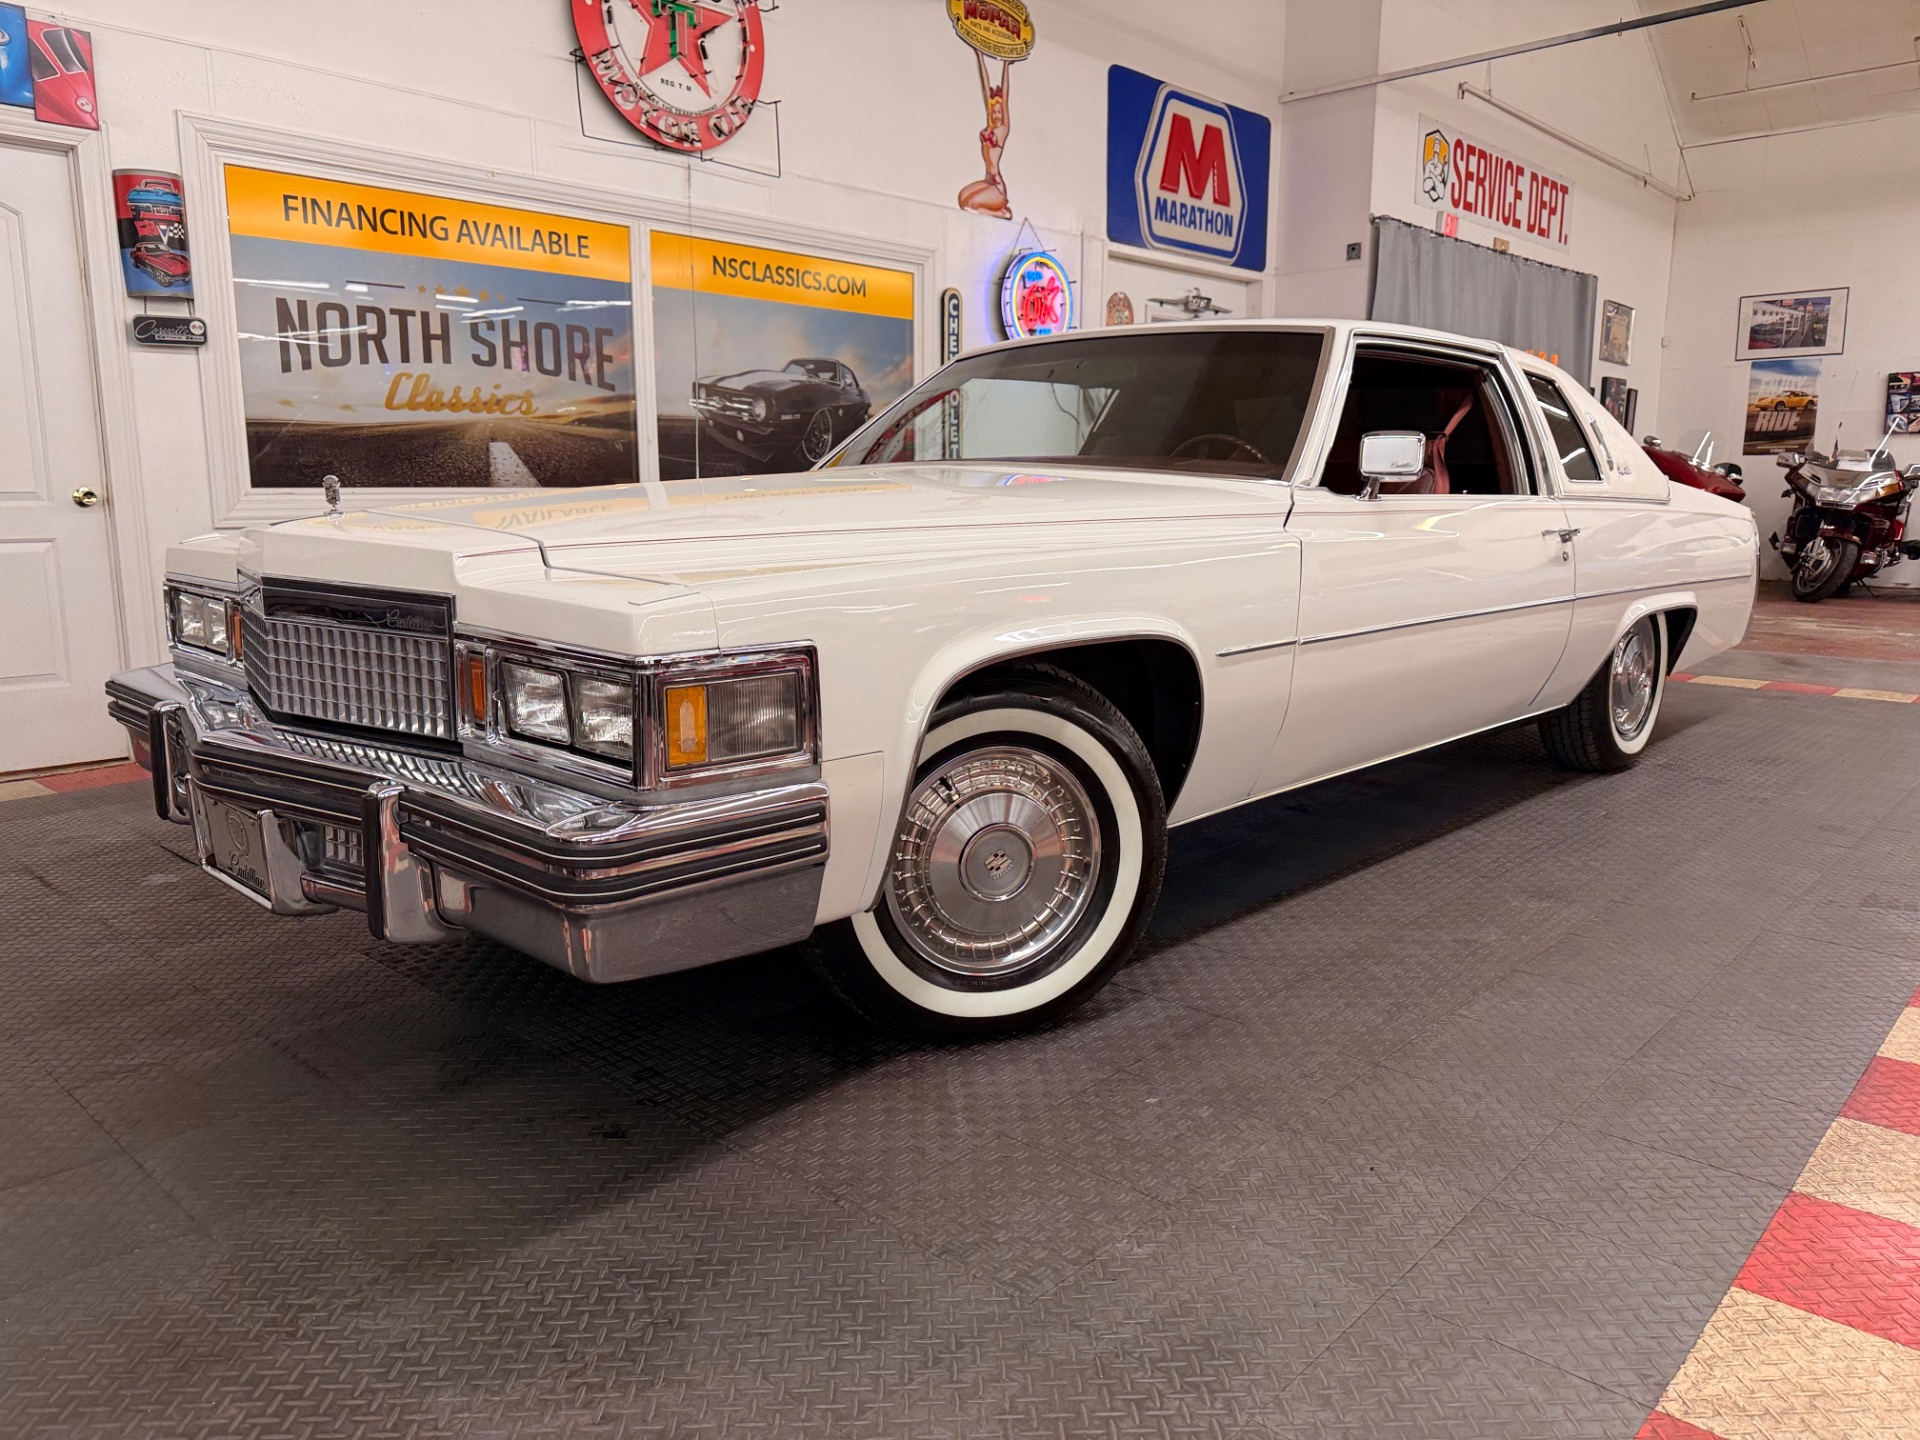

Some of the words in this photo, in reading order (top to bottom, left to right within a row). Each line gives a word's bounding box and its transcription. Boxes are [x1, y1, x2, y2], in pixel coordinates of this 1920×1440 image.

[1450, 138, 1525, 229] SERVICE
[1527, 170, 1569, 246] DEPT.
[282, 194, 449, 241] FINANCING
[456, 219, 590, 259] AVAILABLE
[1153, 196, 1233, 238] MARATHON
[712, 255, 867, 298] NSCLASSICS.COM
[134, 319, 192, 338] Corvette
[274, 297, 452, 374] NORTH
[470, 314, 616, 392] SHORE
[384, 371, 539, 416] Classics
[1754, 411, 1802, 432] RIDE
[382, 608, 440, 632] Cadillac
[228, 852, 266, 890] Cadillac
